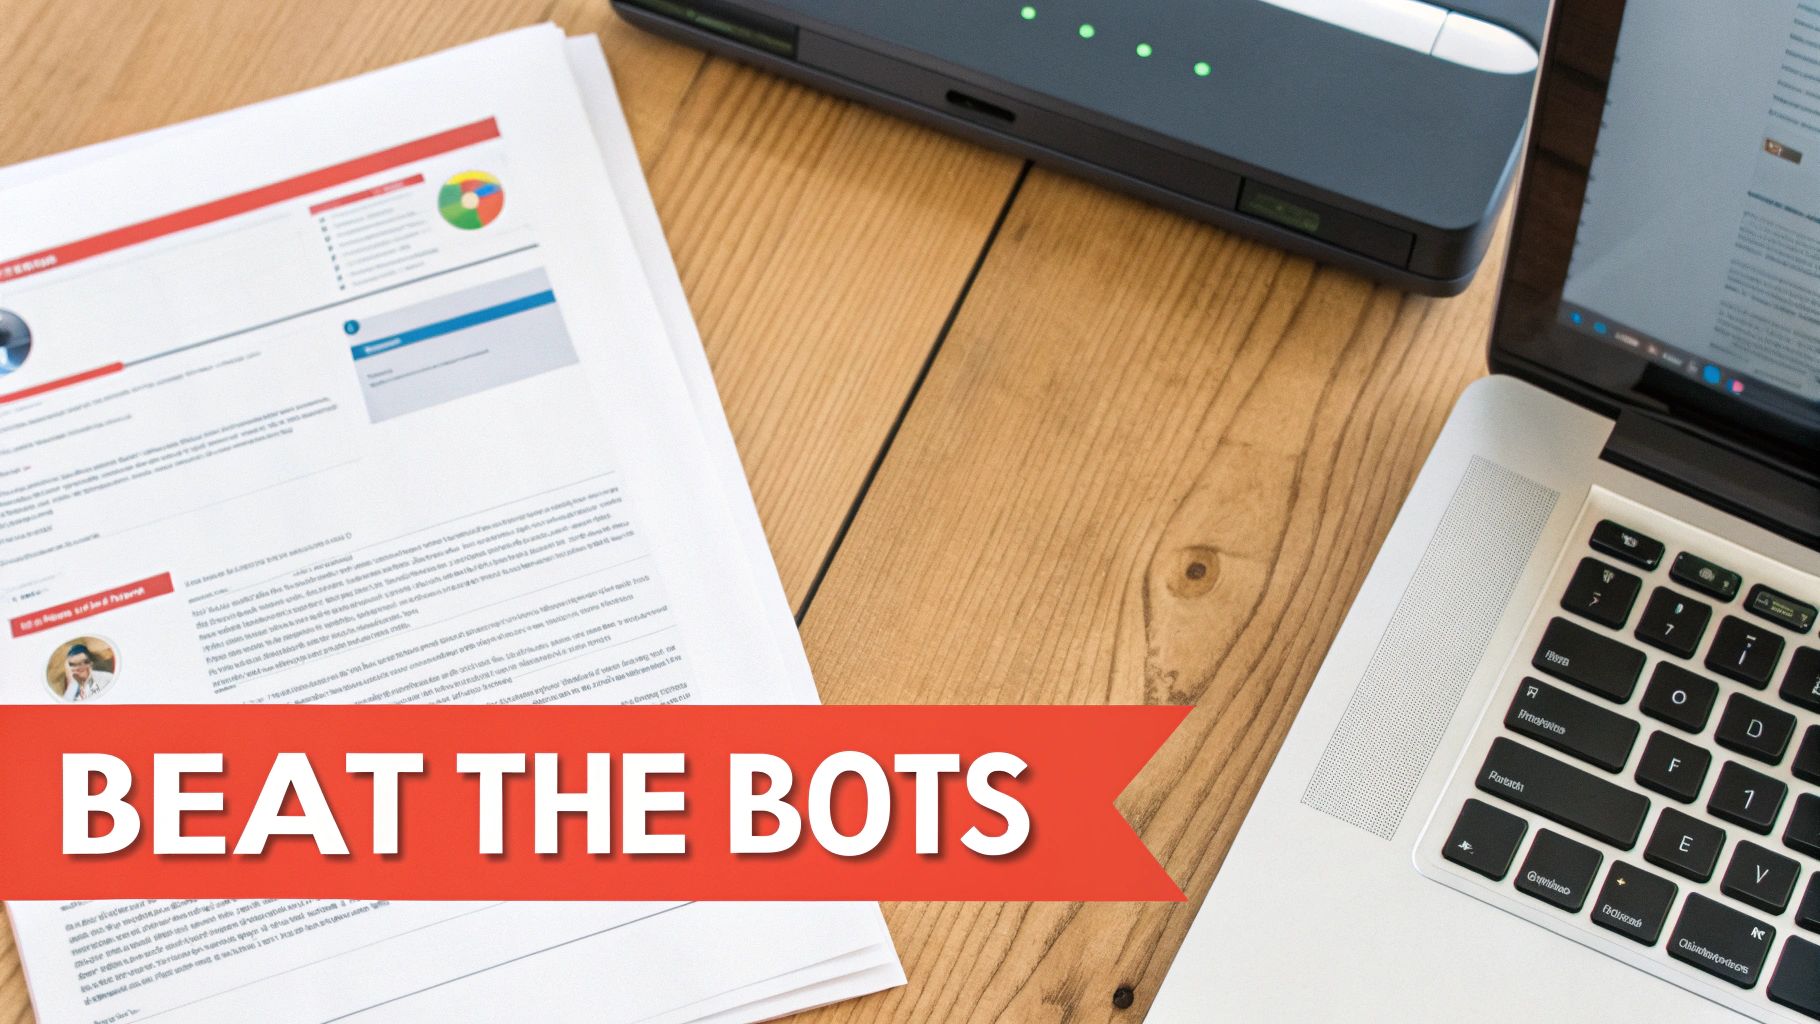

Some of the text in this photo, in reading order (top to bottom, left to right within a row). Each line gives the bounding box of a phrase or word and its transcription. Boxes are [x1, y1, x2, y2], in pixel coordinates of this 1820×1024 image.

[1746, 719, 1763, 739] D
[1667, 757, 1682, 773] F
[1678, 835, 1694, 853] E
[1756, 864, 1770, 884] V
